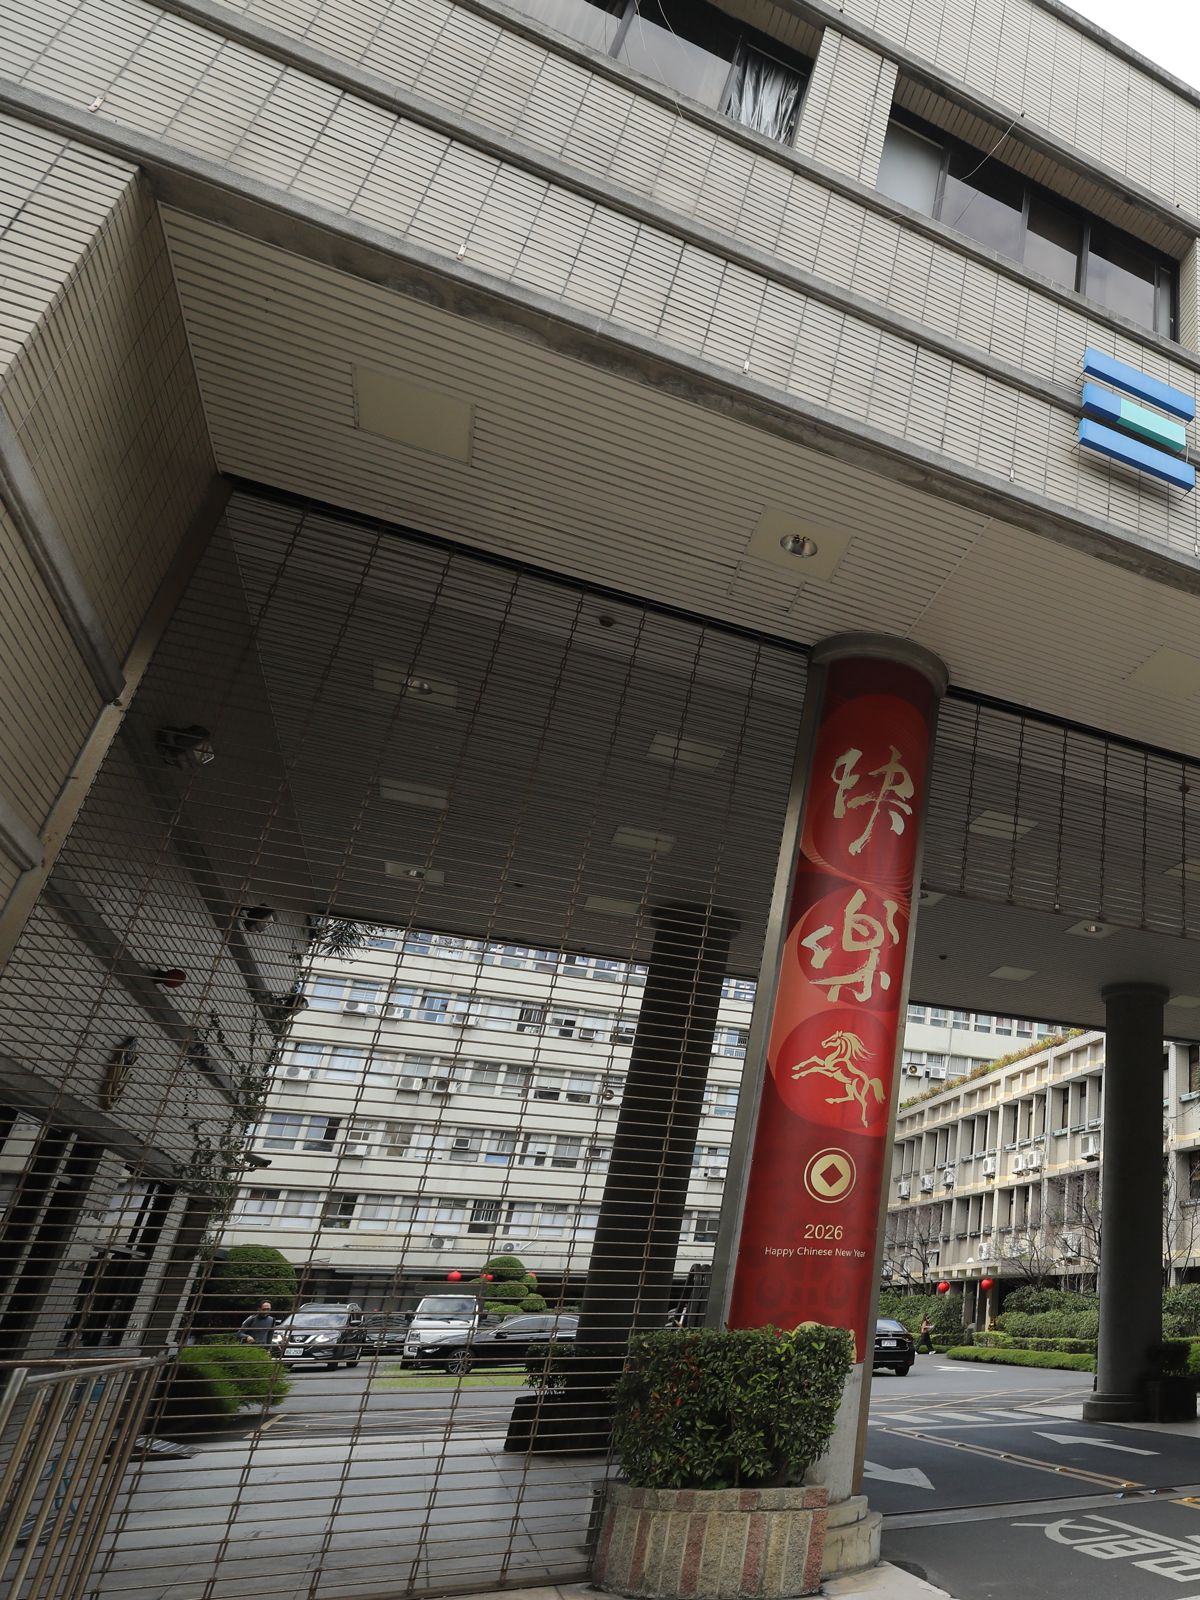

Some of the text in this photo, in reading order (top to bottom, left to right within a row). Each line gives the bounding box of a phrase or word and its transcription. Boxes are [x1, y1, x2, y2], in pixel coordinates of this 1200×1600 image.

[801, 745, 914, 1002] 快樂
[803, 1223, 844, 1241] 2026
[764, 1245, 866, 1258] Happy Chinese New Year
